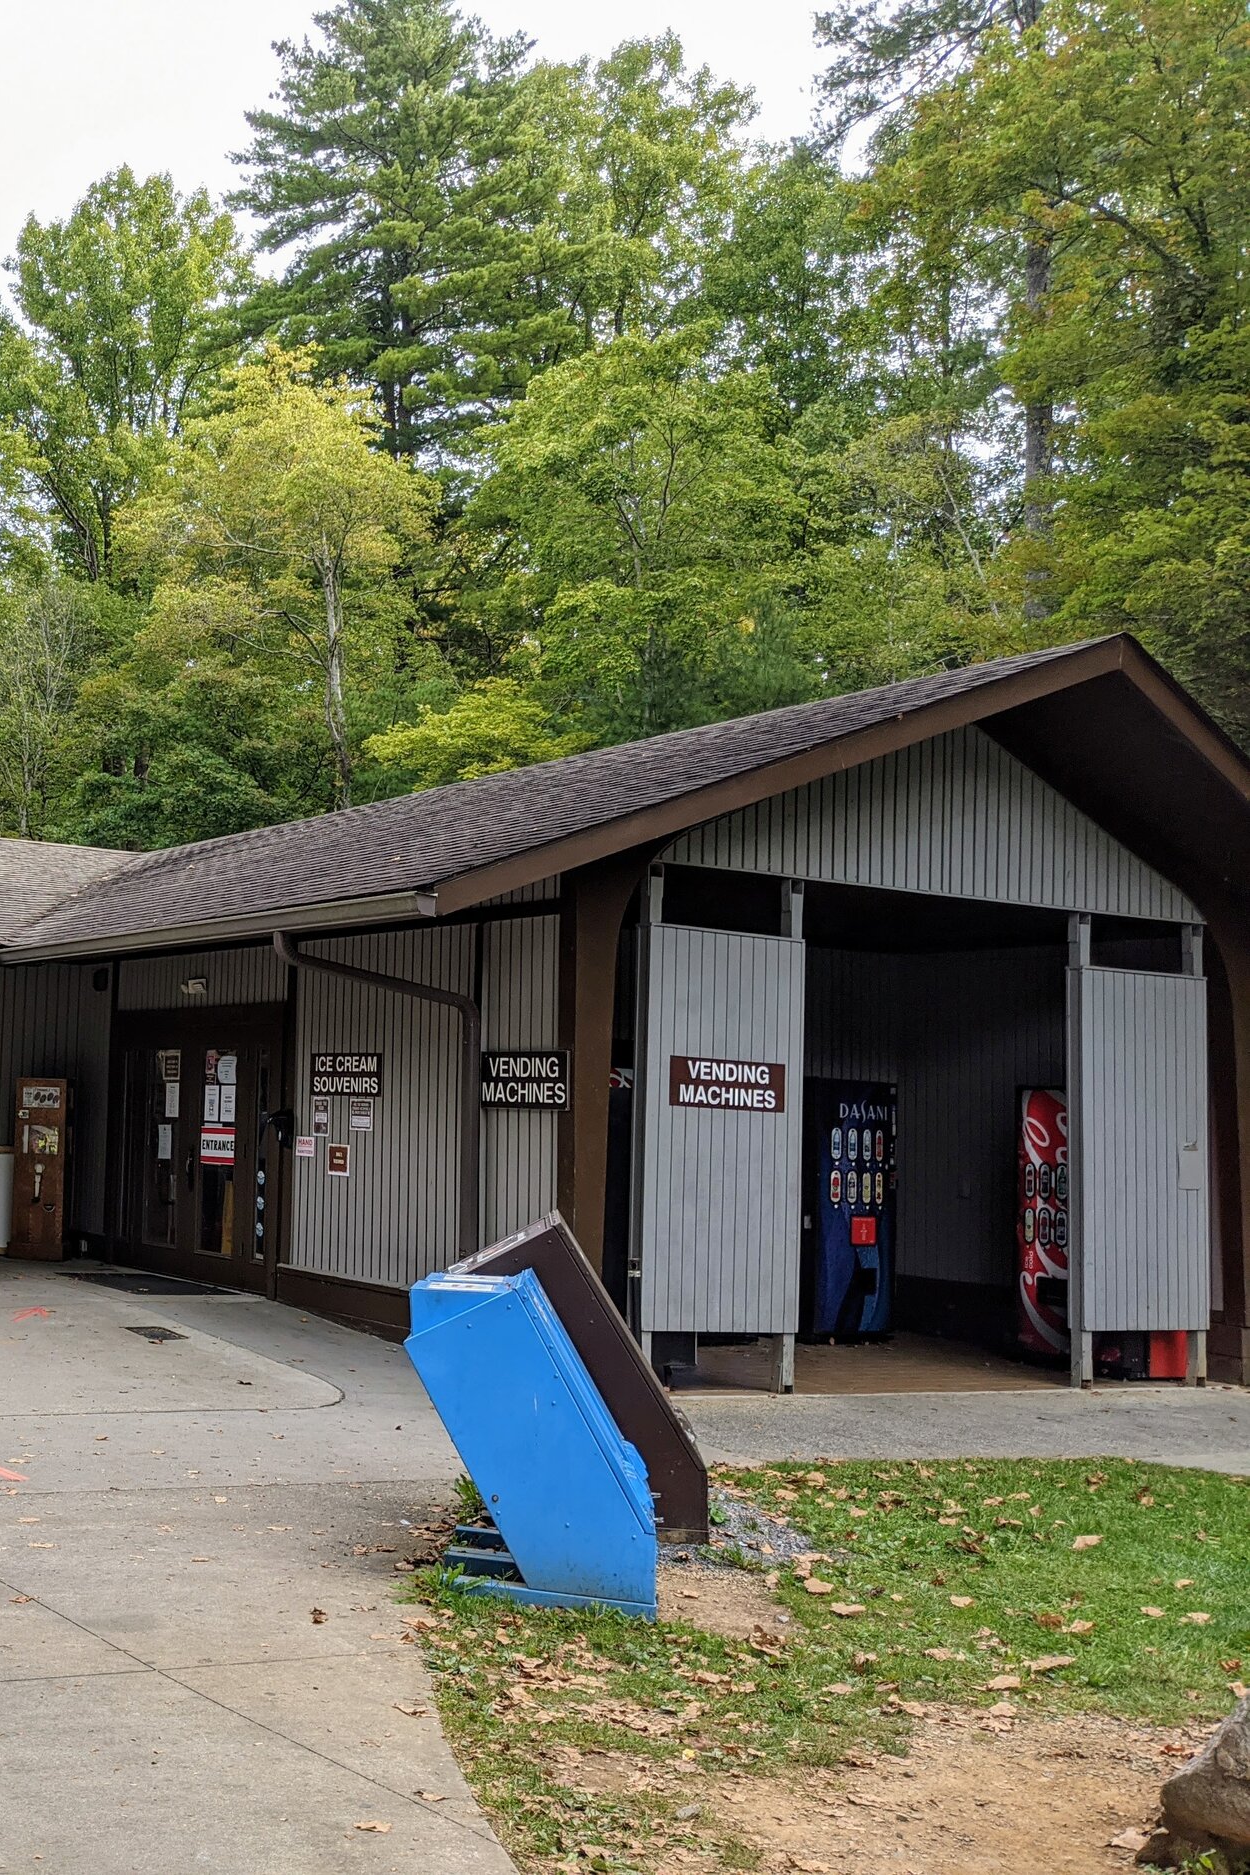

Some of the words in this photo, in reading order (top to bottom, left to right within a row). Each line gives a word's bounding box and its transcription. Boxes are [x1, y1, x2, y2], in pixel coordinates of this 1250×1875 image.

[315, 1056, 333, 1072] ICE
[336, 1056, 377, 1072] CREAM
[489, 1057, 559, 1078] VENDING
[687, 1060, 769, 1085] VENDING
[313, 1076, 378, 1094] SOUVENIRS
[482, 1082, 566, 1104] MACHINES
[679, 1084, 776, 1109] MACHINES
[839, 1100, 888, 1123] DASANI
[202, 1139, 235, 1151] ENTRANCE
[297, 1138, 313, 1146] HAND
